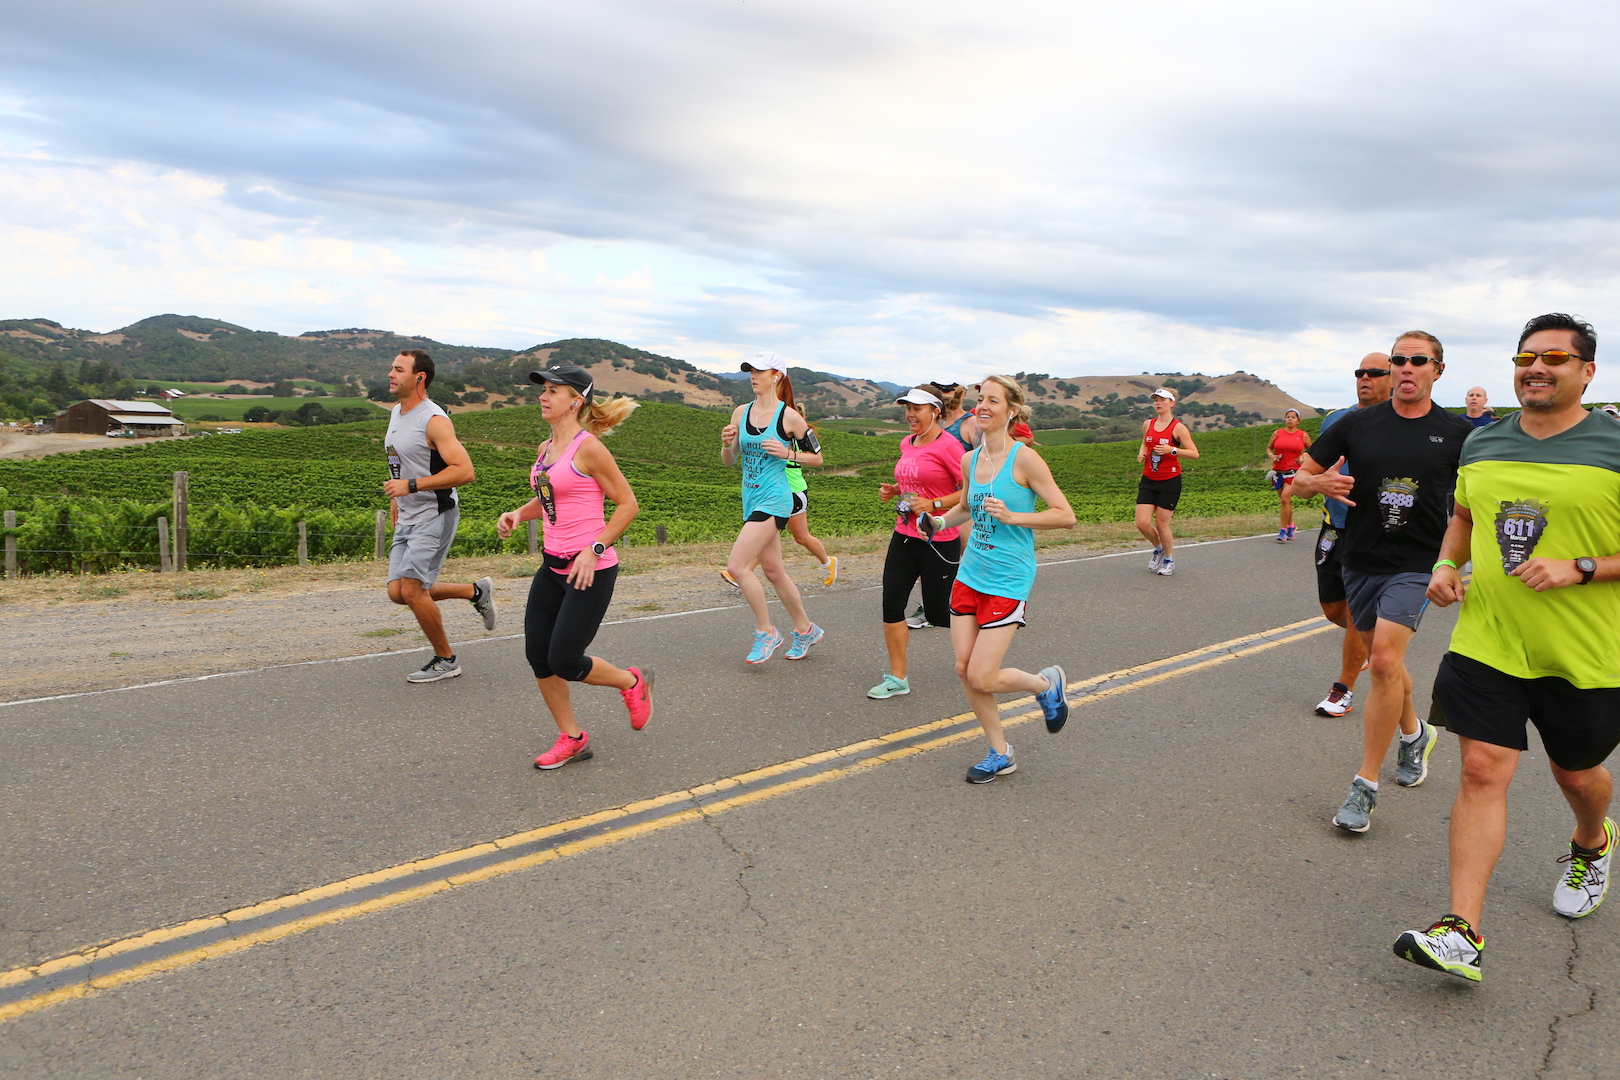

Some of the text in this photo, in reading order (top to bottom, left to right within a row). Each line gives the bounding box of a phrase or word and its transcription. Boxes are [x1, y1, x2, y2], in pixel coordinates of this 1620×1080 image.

[901, 457, 917, 466] WILL
[895, 465, 919, 478] RUN
[1379, 490, 1414, 508] 2688
[1503, 517, 1535, 538] 611
